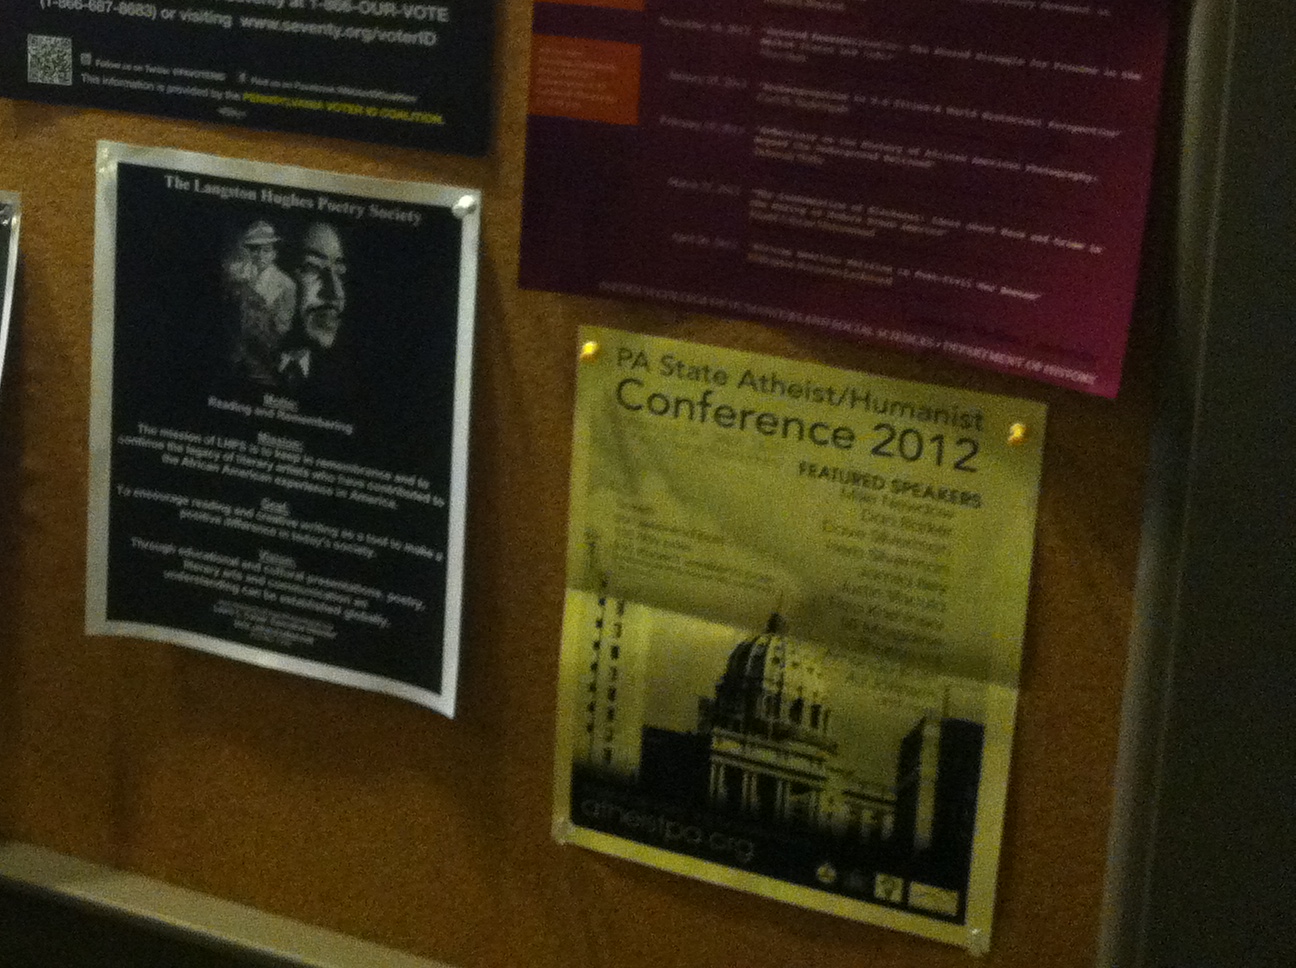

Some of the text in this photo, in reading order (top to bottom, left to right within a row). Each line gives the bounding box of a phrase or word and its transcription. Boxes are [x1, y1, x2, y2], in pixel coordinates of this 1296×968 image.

[160, 8, 178, 20] or
[81, 73, 102, 86] This
[163, 175, 423, 226] The Langston Hughes Poetry Society
[615, 346, 985, 433] PA State Atheist/Humanist
[207, 395, 355, 436] Reading and Remembering
[615, 377, 980, 475] Conference 2012
[138, 422, 158, 438] The
[159, 426, 202, 445] mission
[203, 433, 216, 446] of
[260, 445, 273, 457] to
[274, 447, 301, 465] keep
[303, 454, 314, 465] in
[393, 471, 416, 485] and
[417, 477, 431, 490] to
[161, 452, 179, 467] the
[180, 455, 221, 474] African
[221, 463, 273, 484] American
[274, 474, 333, 498] experience
[334, 485, 347, 499] in
[166, 438, 184, 453] the
[185, 442, 221, 462] legacy
[222, 450, 234, 463] of
[236, 452, 274, 474] literary
[275, 461, 310, 479] artists
[312, 469, 336, 484] who
[337, 473, 365, 489] have
[366, 478, 431, 504] contributed
[797, 461, 984, 510] FEATURED SPEAKERS
[116, 484, 131, 499] To
[132, 487, 190, 508] encourage
[190, 497, 232, 518] reading
[233, 505, 255, 520] and
[300, 518, 339, 540] writing
[179, 508, 332, 550] positive difference in today's
[130, 535, 176, 556] Through
[177, 544, 241, 567] educational
[241, 559, 262, 573] and
[183, 559, 221, 579] literary
[245, 573, 267, 587] and
[163, 569, 241, 595] understanding
